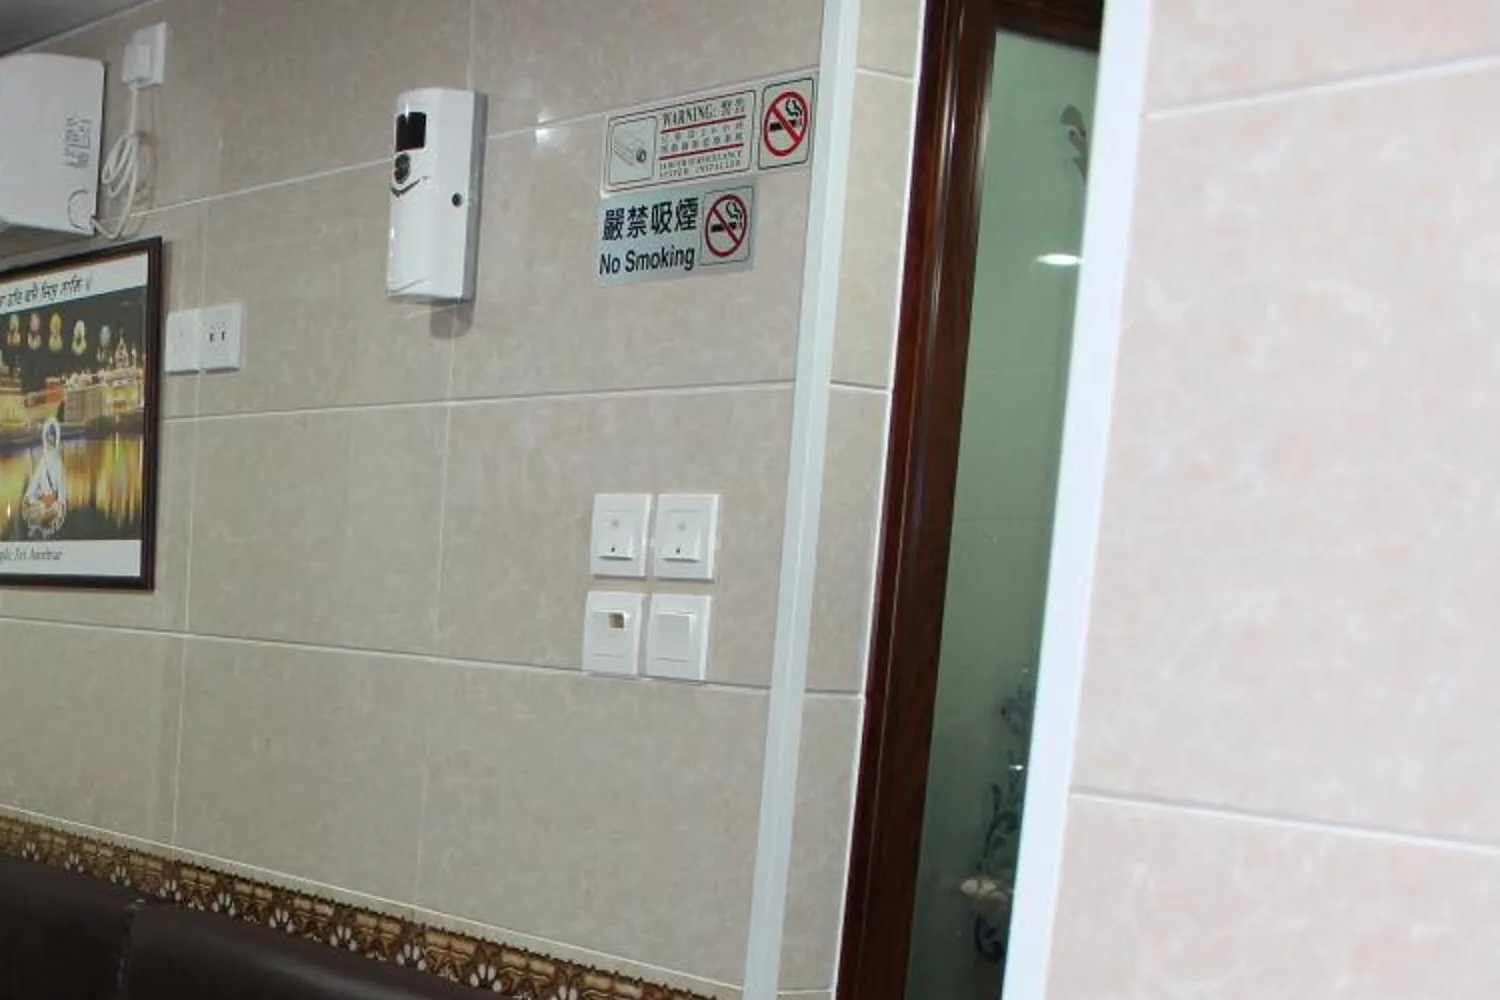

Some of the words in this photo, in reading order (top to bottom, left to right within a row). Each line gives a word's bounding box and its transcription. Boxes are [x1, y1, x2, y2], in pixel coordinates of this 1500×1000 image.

[602, 197, 698, 240] 嚴禁吸煙
[600, 253, 621, 275] No
[625, 244, 695, 272] Smoking
